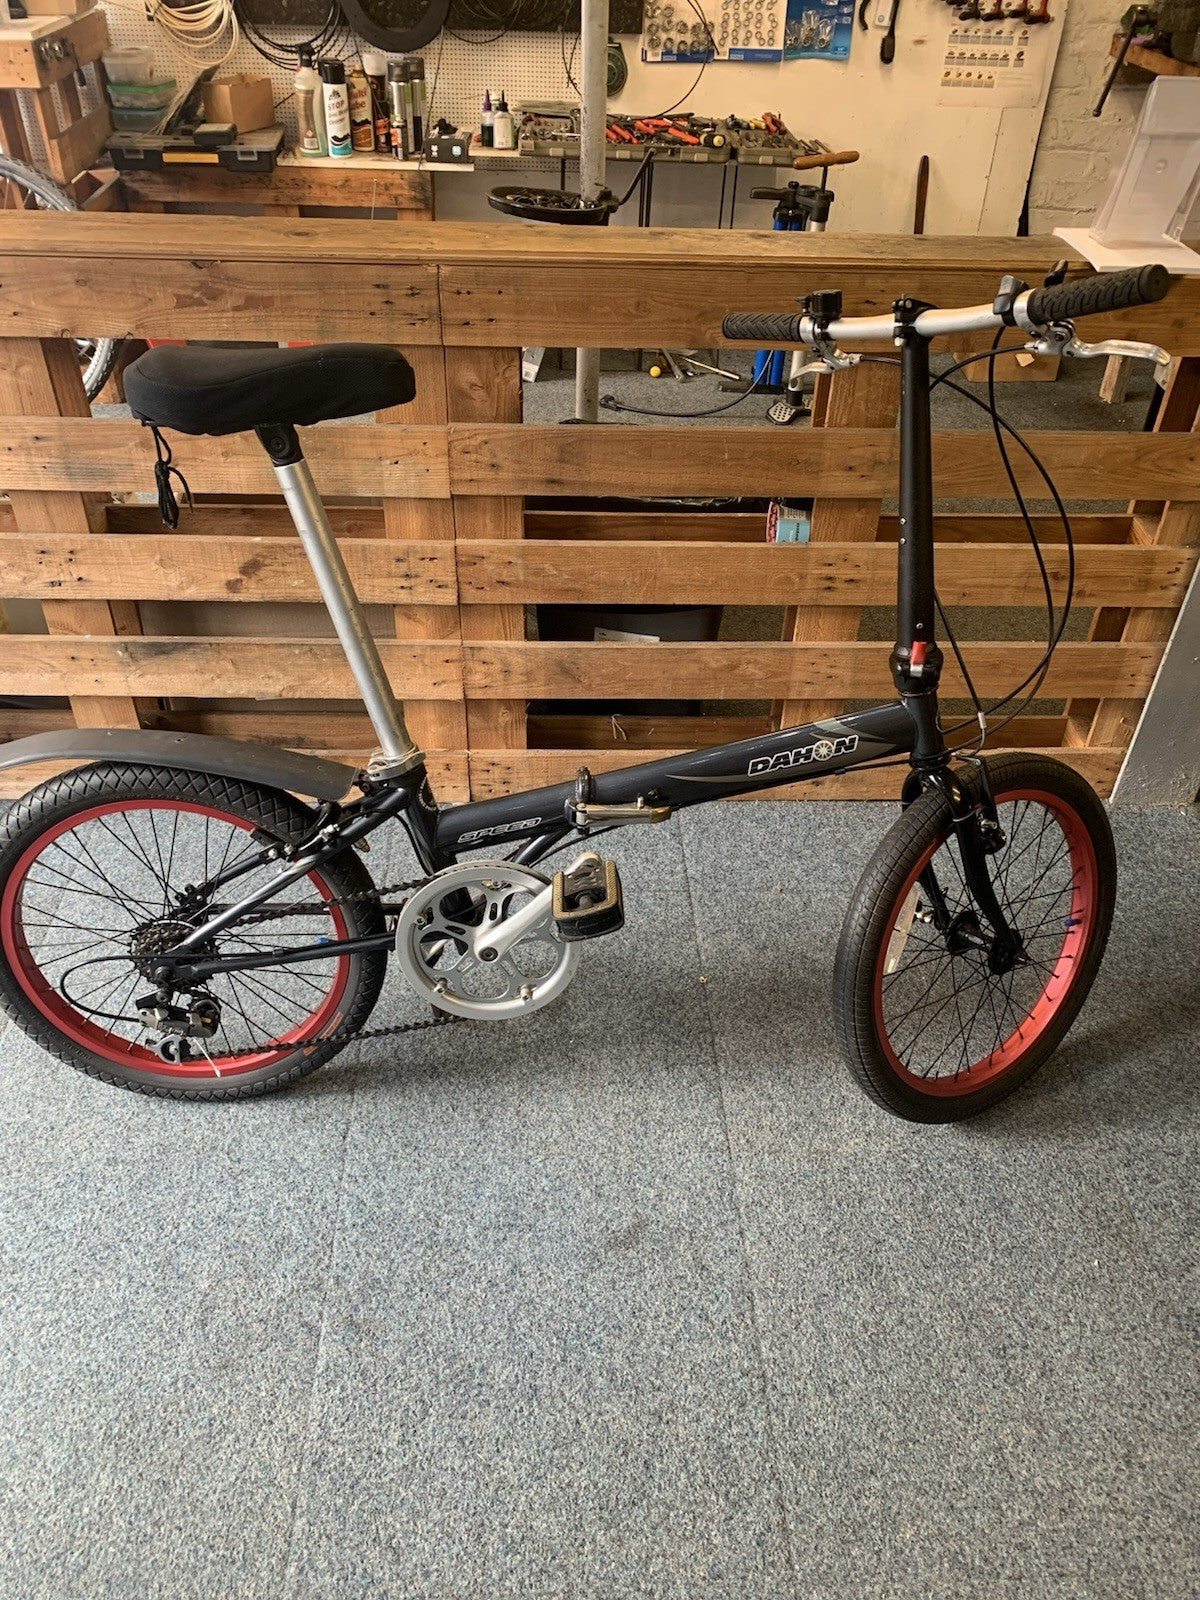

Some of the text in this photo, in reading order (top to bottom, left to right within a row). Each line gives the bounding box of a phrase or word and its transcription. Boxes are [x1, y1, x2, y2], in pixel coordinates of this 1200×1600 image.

[328, 100, 345, 111] STOP
[748, 735, 859, 776] DAHON
[457, 817, 542, 843] SPEED
